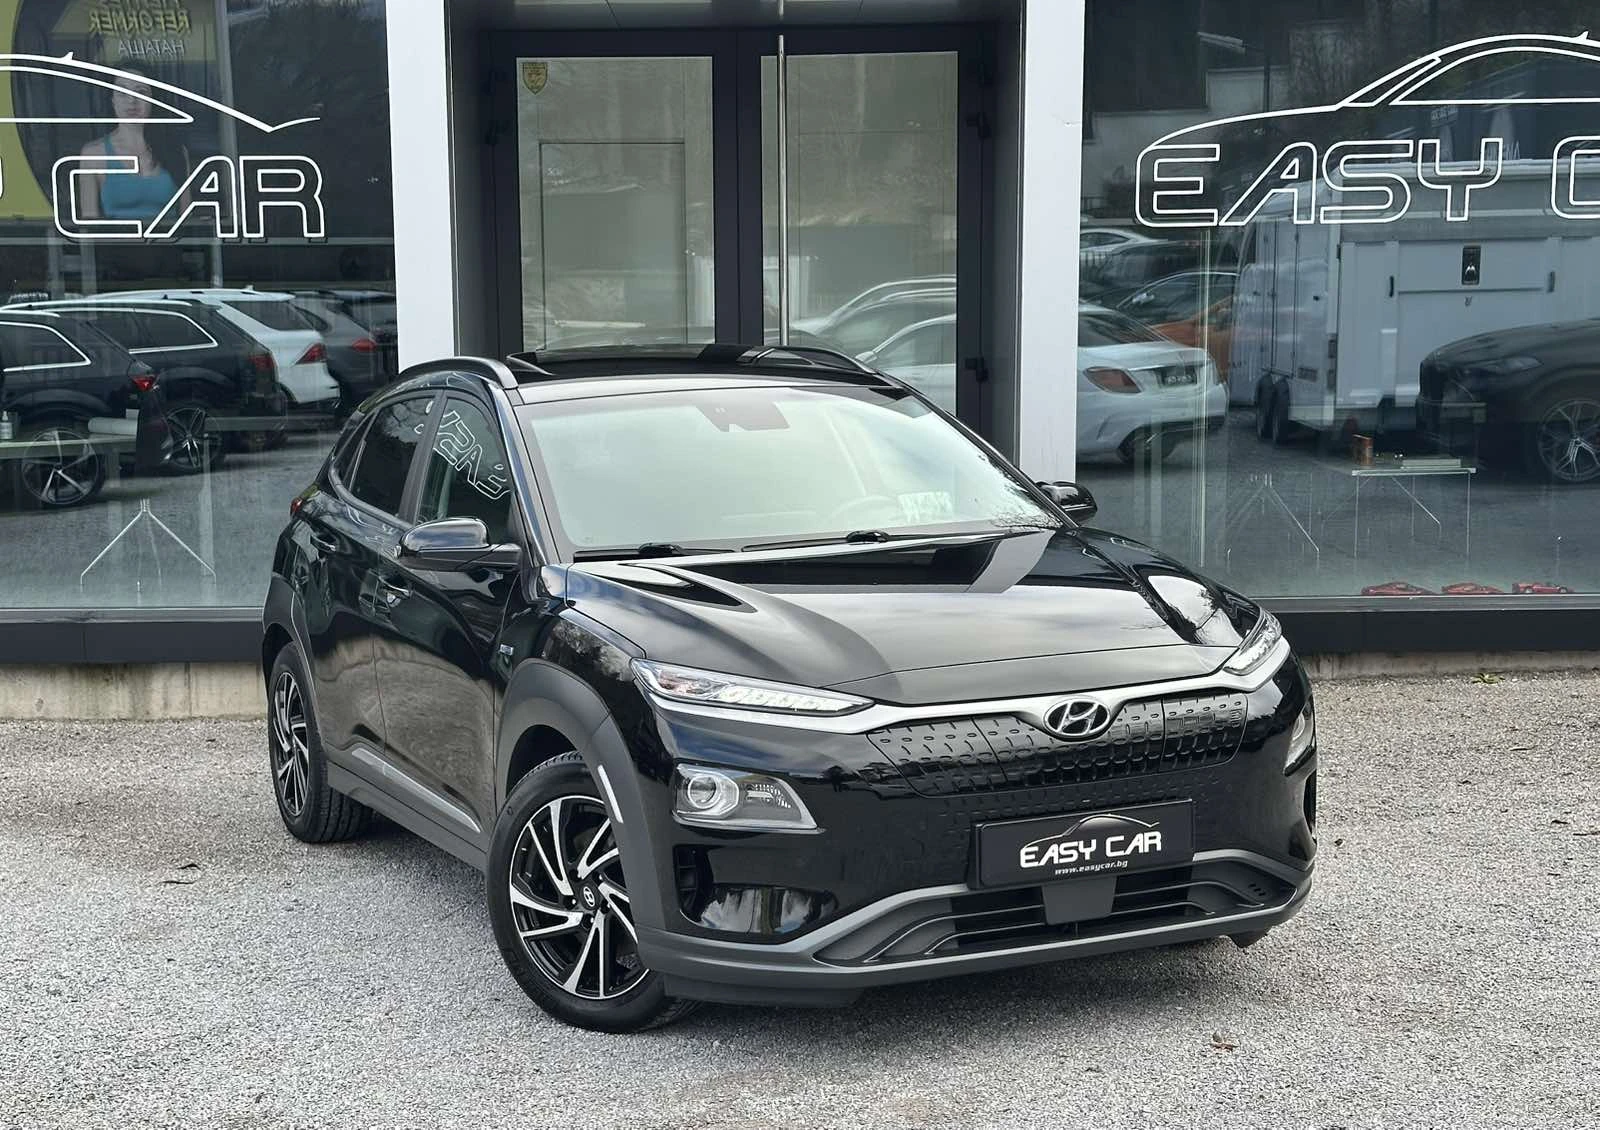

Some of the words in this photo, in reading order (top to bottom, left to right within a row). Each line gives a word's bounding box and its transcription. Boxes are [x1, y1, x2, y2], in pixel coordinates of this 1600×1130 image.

[52, 155, 325, 239] CAR
[1135, 137, 1503, 227] EASY
[1019, 839, 1097, 869] EASY
[1105, 831, 1162, 858] CAR
[1054, 859, 1129, 875] www.easycar.bg
